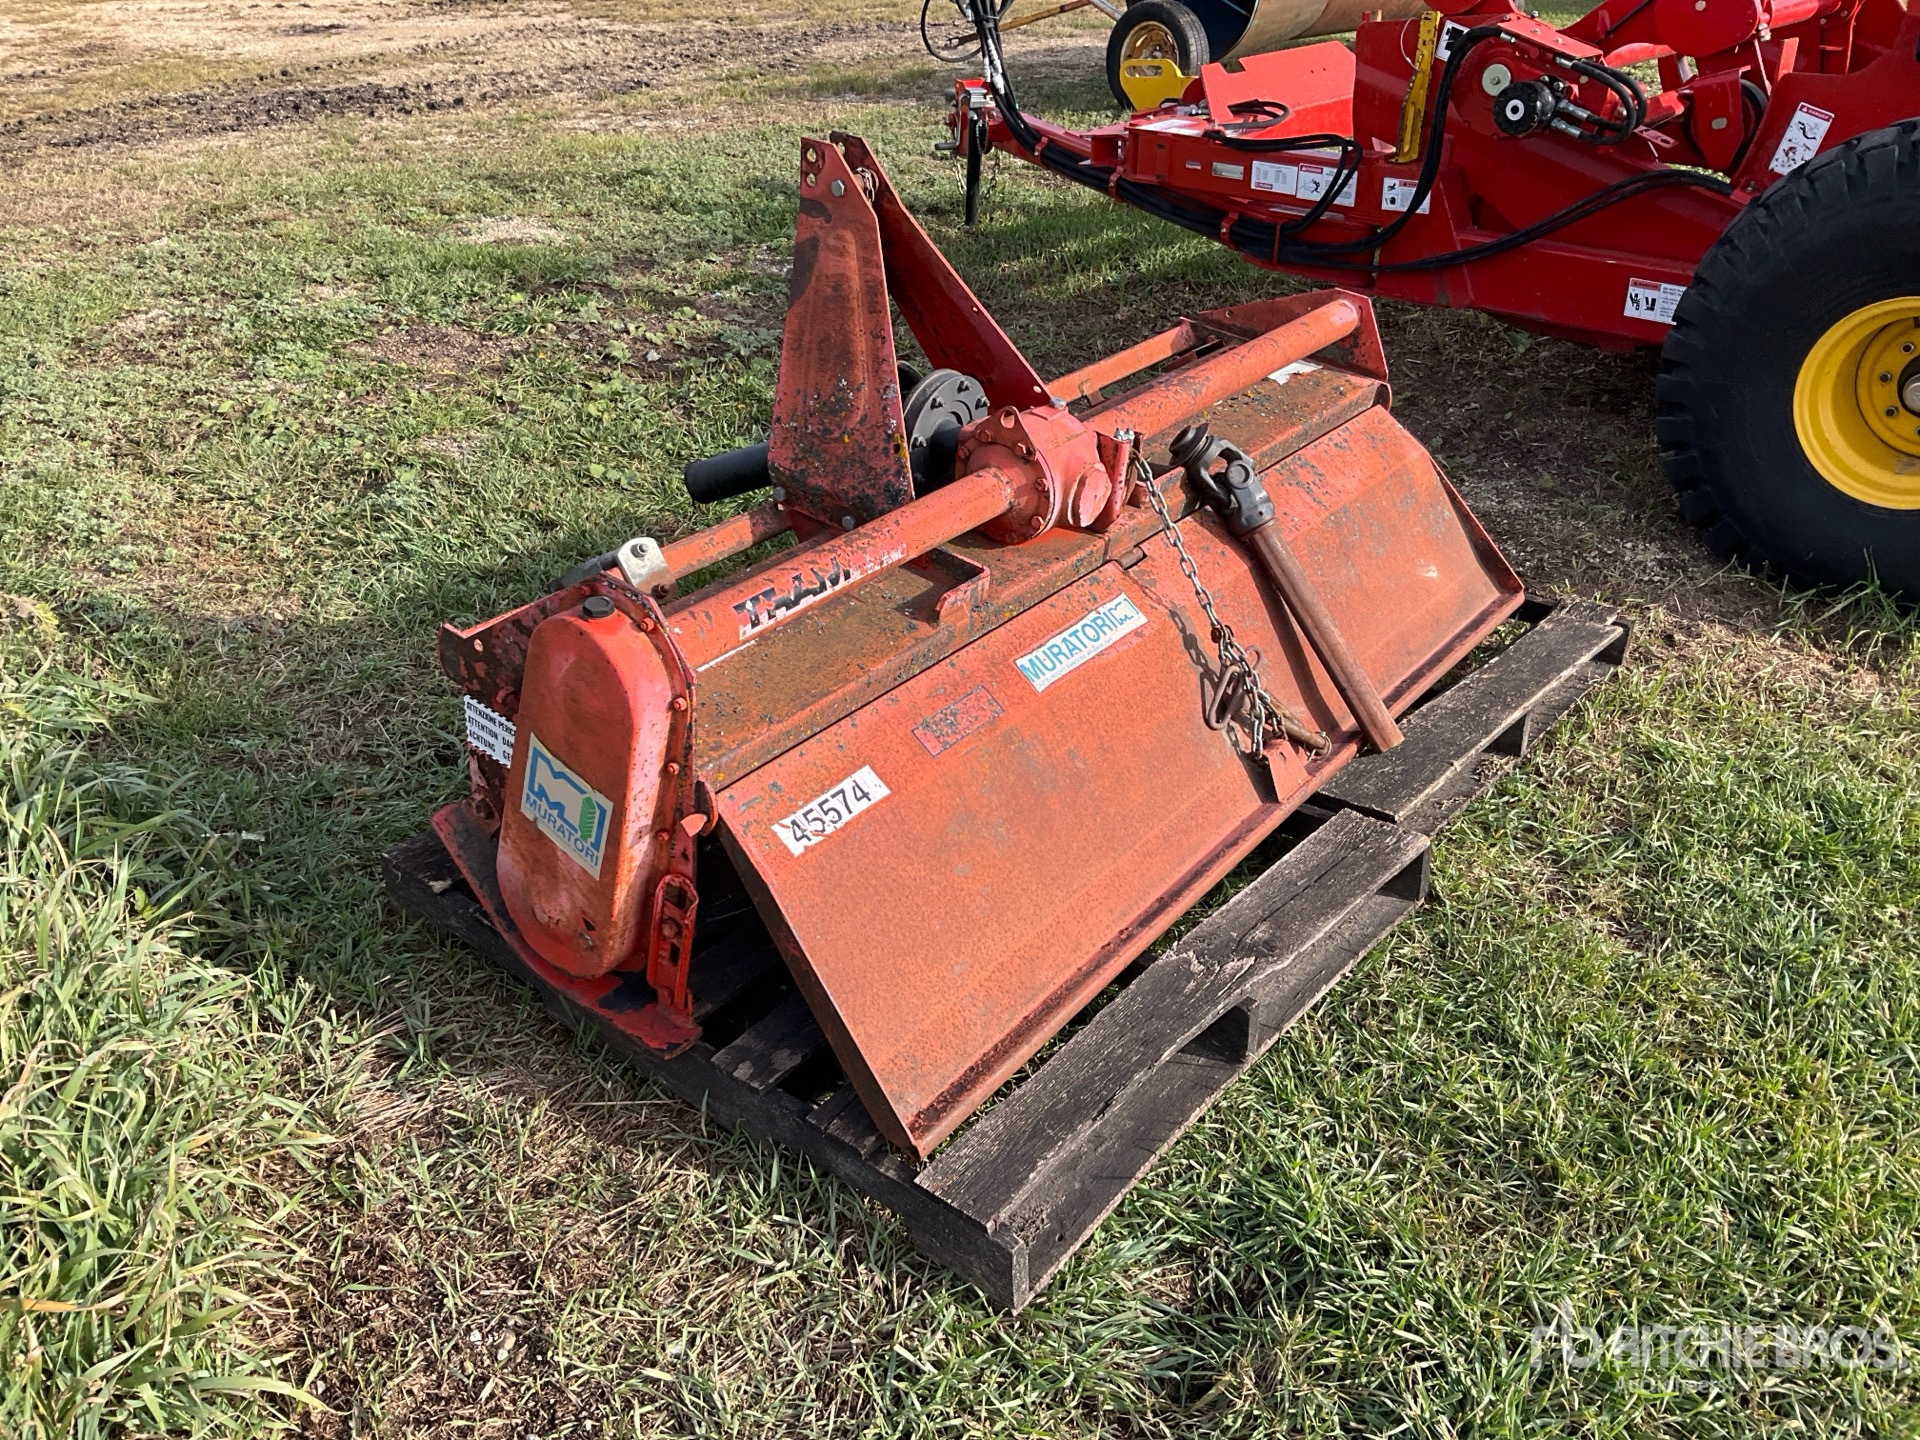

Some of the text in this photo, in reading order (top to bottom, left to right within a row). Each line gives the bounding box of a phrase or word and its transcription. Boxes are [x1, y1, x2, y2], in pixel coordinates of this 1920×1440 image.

[1019, 611, 1118, 683] MURATORI
[466, 702, 498, 728] ATTENZIONE
[468, 715, 499, 742] ATTENTION
[469, 729, 496, 753] ACHTUNG
[525, 792, 599, 867] MURATORI
[790, 779, 872, 843] 45574
